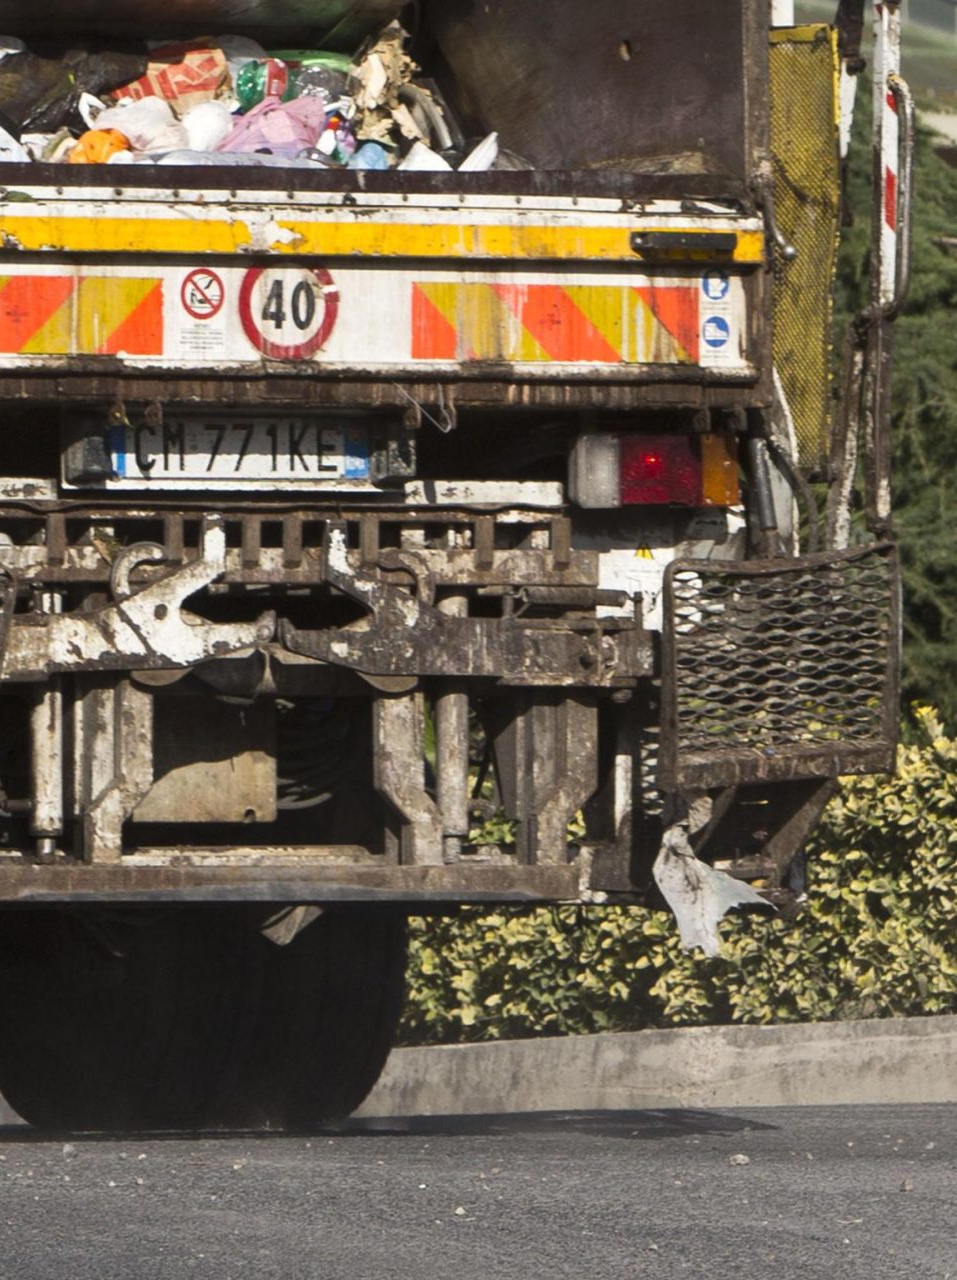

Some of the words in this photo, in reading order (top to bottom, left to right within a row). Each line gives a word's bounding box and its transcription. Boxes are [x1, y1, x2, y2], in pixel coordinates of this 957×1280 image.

[261, 278, 315, 331] 40
[134, 422, 185, 474] CM
[204, 422, 338, 473] 771KE
